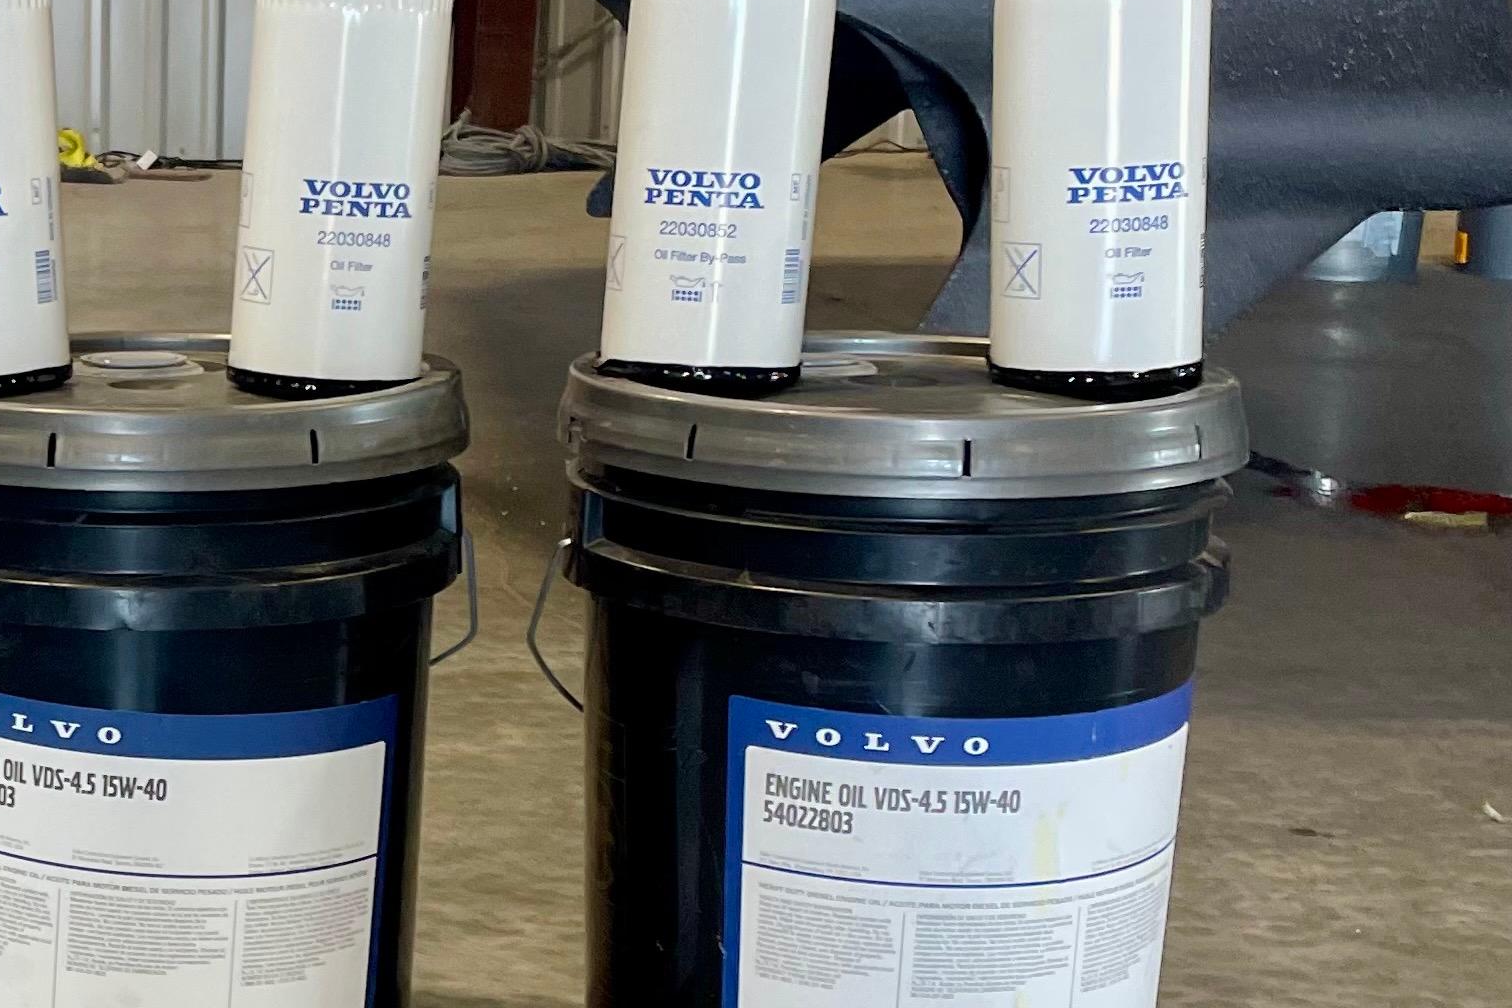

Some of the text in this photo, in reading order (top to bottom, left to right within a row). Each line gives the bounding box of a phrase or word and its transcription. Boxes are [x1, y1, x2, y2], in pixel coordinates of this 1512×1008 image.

[647, 168, 761, 190] VOLVO
[1069, 162, 1185, 185] VOLVO
[303, 179, 411, 200] VOLVO
[644, 187, 765, 209] PENTA
[1066, 182, 1190, 204] PENTA
[299, 197, 412, 218] PENTA
[659, 220, 737, 238] 22030852
[1089, 215, 1169, 234] 22030848
[317, 230, 391, 248] 22030848
[654, 249, 747, 265] Oil Filter By-Pass
[1104, 246, 1152, 259] Oil Filter
[330, 260, 374, 272] Oil Filter
[765, 719, 990, 756] VOLVO
[3, 758, 27, 785] OIL
[32, 764, 97, 795] VDS-4.5
[102, 774, 168, 801] 15W-40
[765, 773, 1022, 814] ENGINE OIL VDS-4.5 15W-40
[763, 800, 854, 835] 54022803
